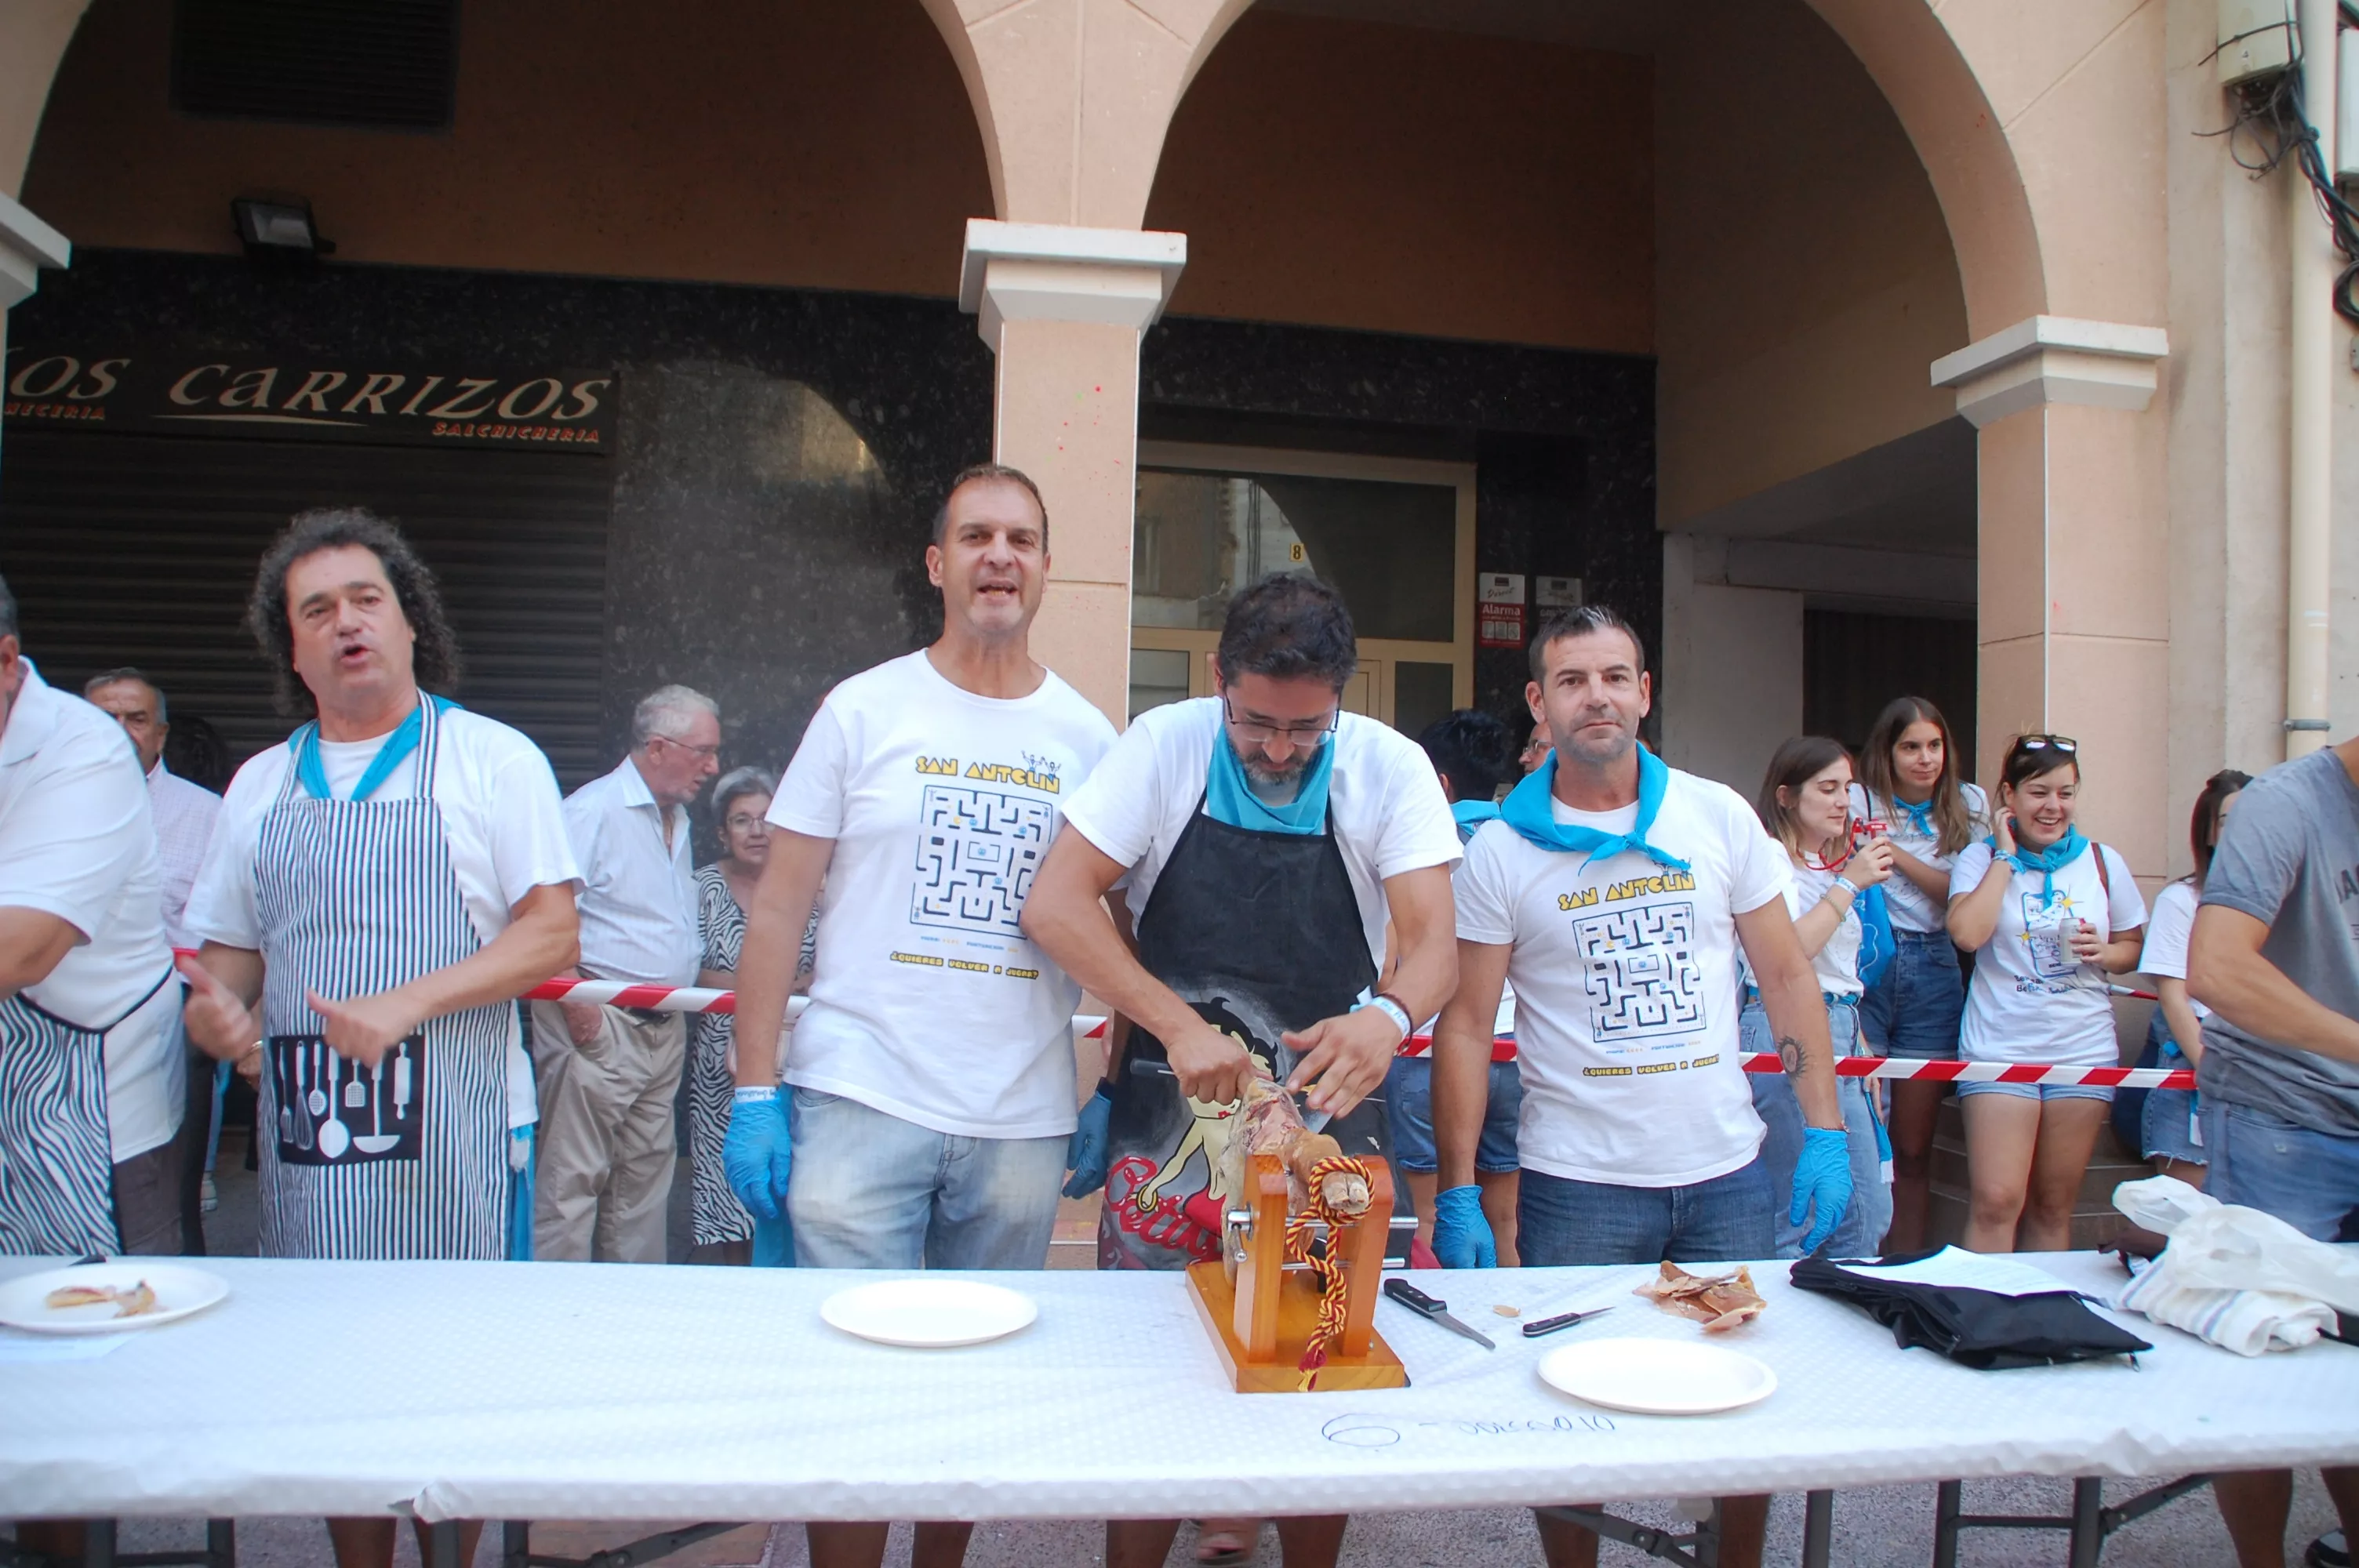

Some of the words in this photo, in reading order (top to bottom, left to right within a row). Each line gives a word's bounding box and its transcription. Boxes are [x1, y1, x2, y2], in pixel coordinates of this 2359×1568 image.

[8, 348, 133, 400] OS
[432, 420, 601, 444] SALCHICHERIA
[1292, 544, 1302, 561] 8
[1482, 604, 1521, 616] Alarma
[915, 756, 958, 776] SAN
[1558, 887, 1599, 911] SAN
